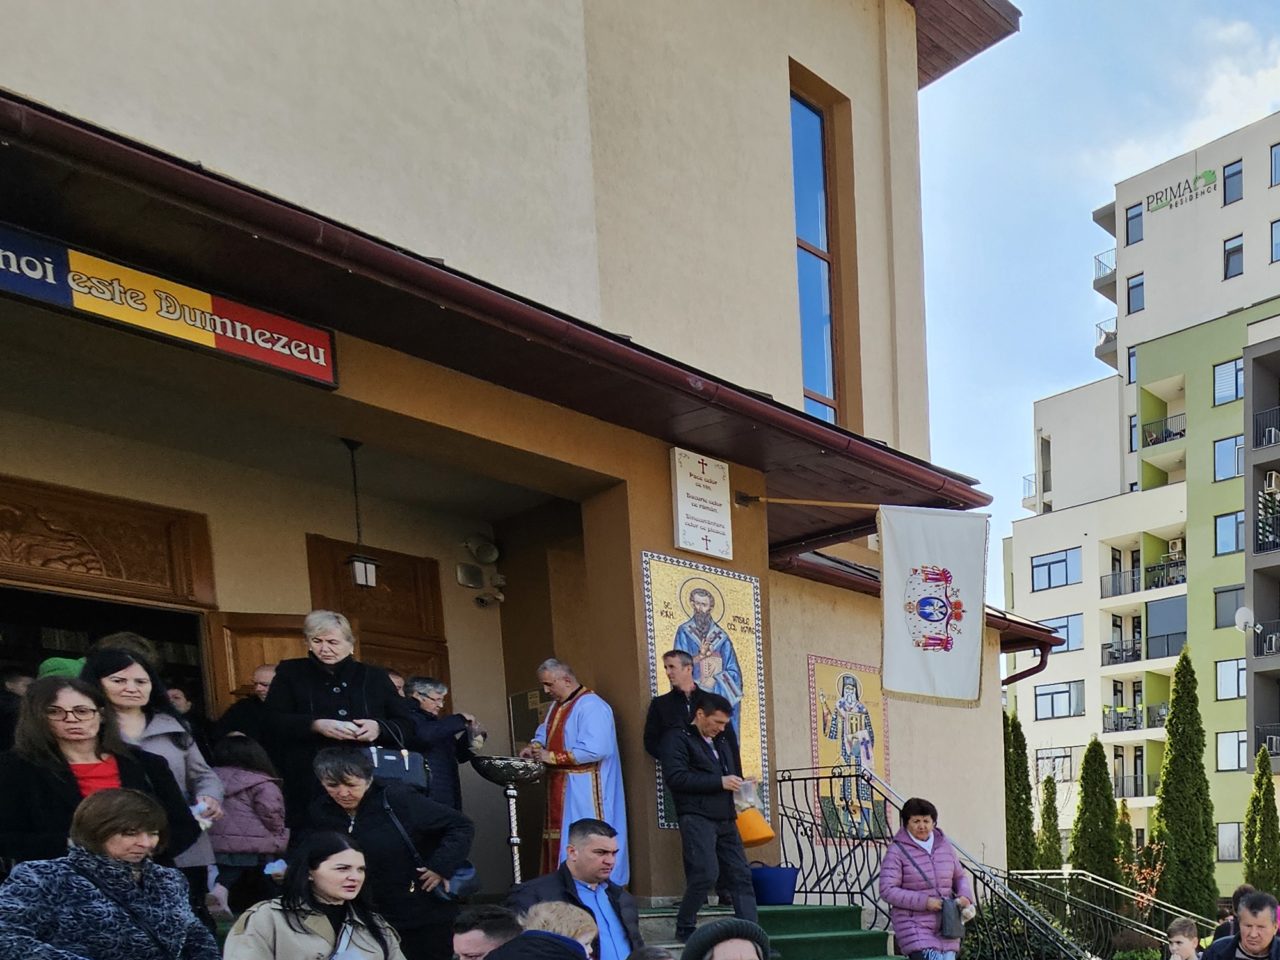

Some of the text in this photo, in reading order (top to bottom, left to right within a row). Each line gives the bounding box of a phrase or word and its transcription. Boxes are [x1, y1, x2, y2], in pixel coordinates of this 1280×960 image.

[1146, 179, 1193, 212] PRIMA
[67, 270, 148, 312] este
[153, 288, 328, 367] Dumnezeu
